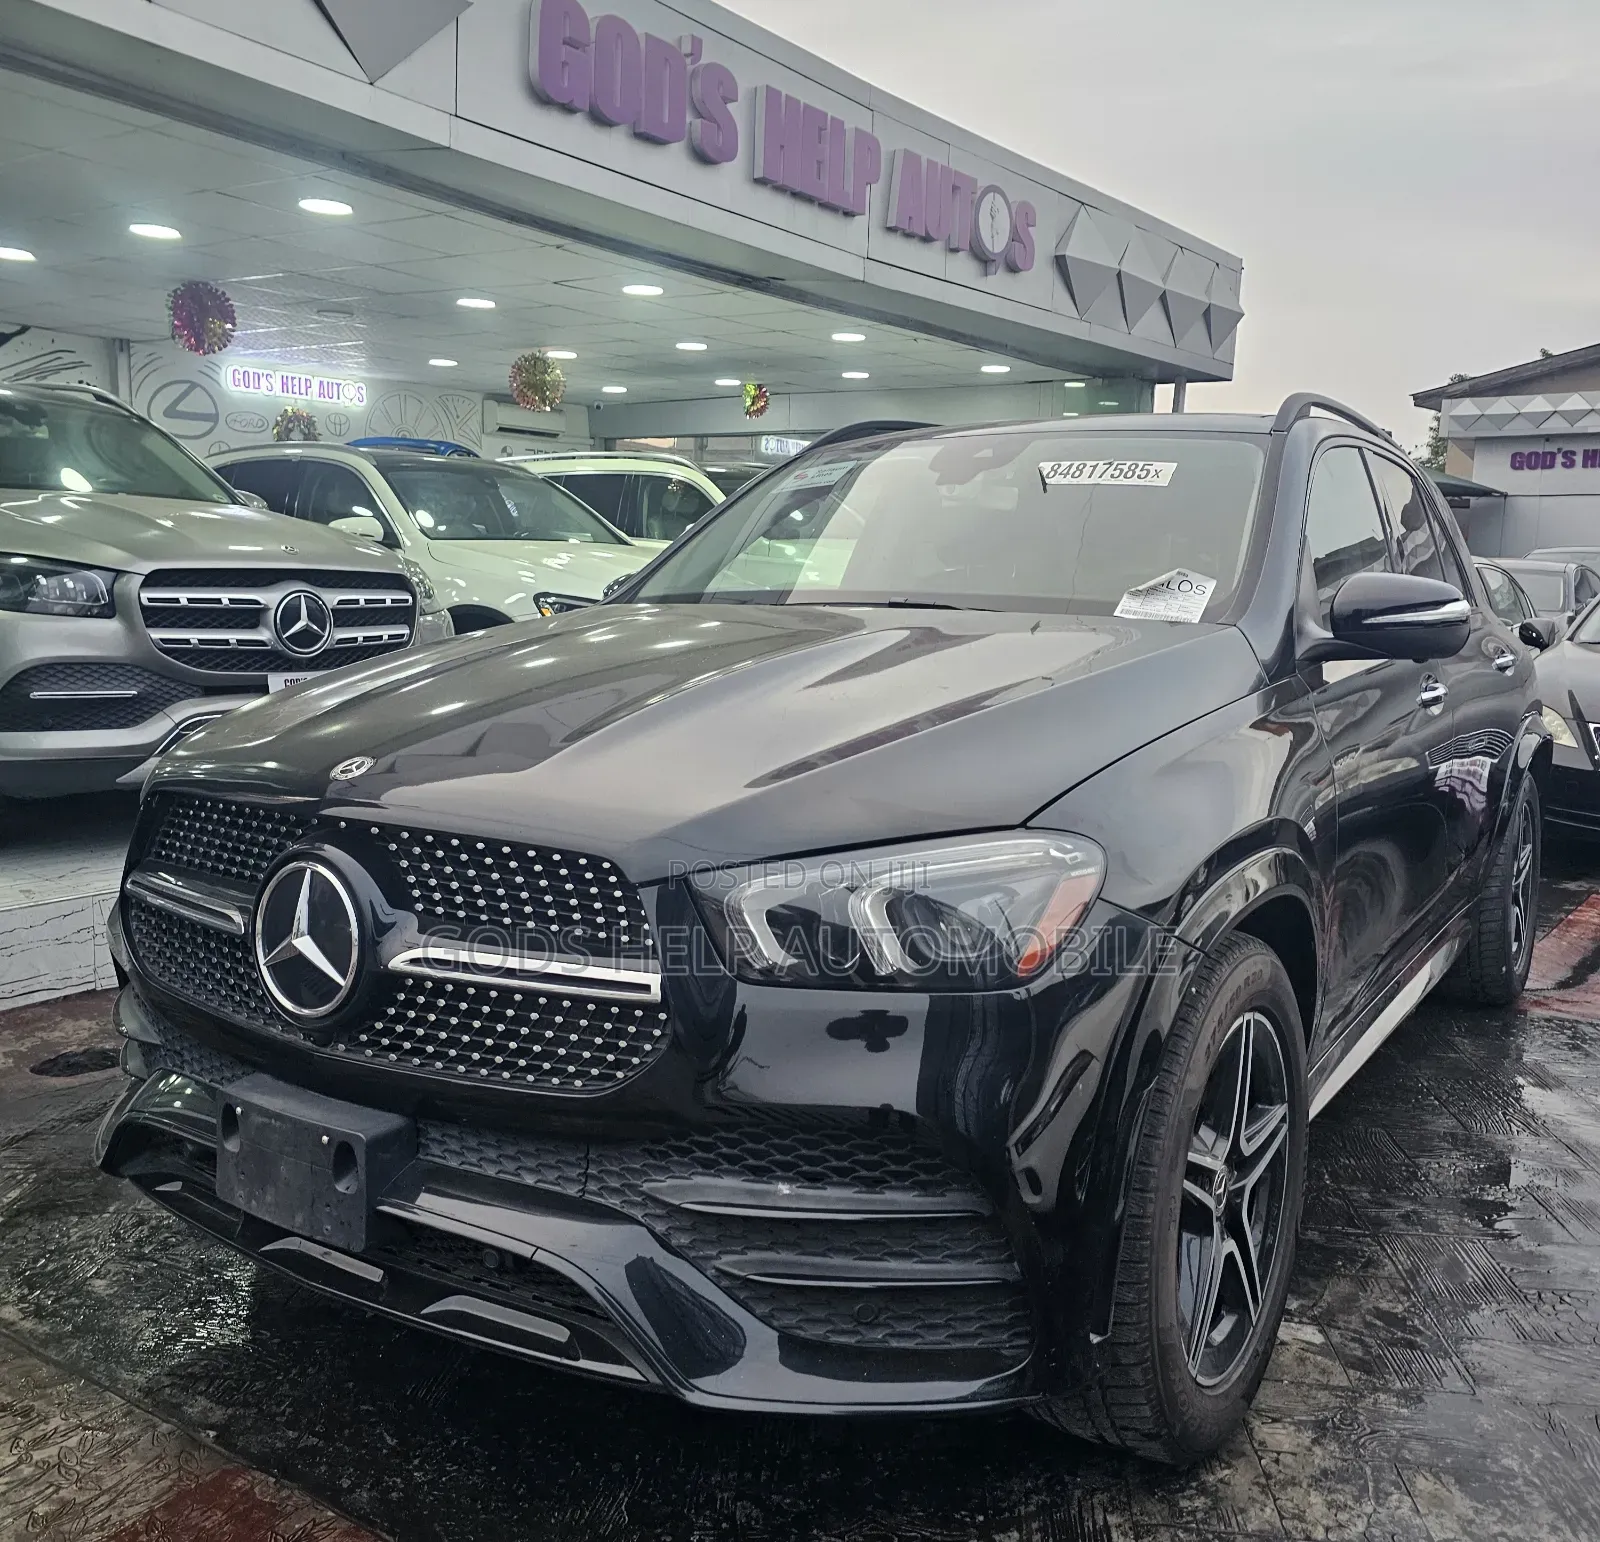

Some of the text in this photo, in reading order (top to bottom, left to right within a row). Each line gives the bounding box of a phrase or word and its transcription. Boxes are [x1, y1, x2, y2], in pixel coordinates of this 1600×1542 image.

[529, 0, 1036, 276] GOD'S HELP AUTOS
[232, 368, 364, 403] GOD'S HELP AUTOS
[1510, 447, 1577, 471] GOD'S
